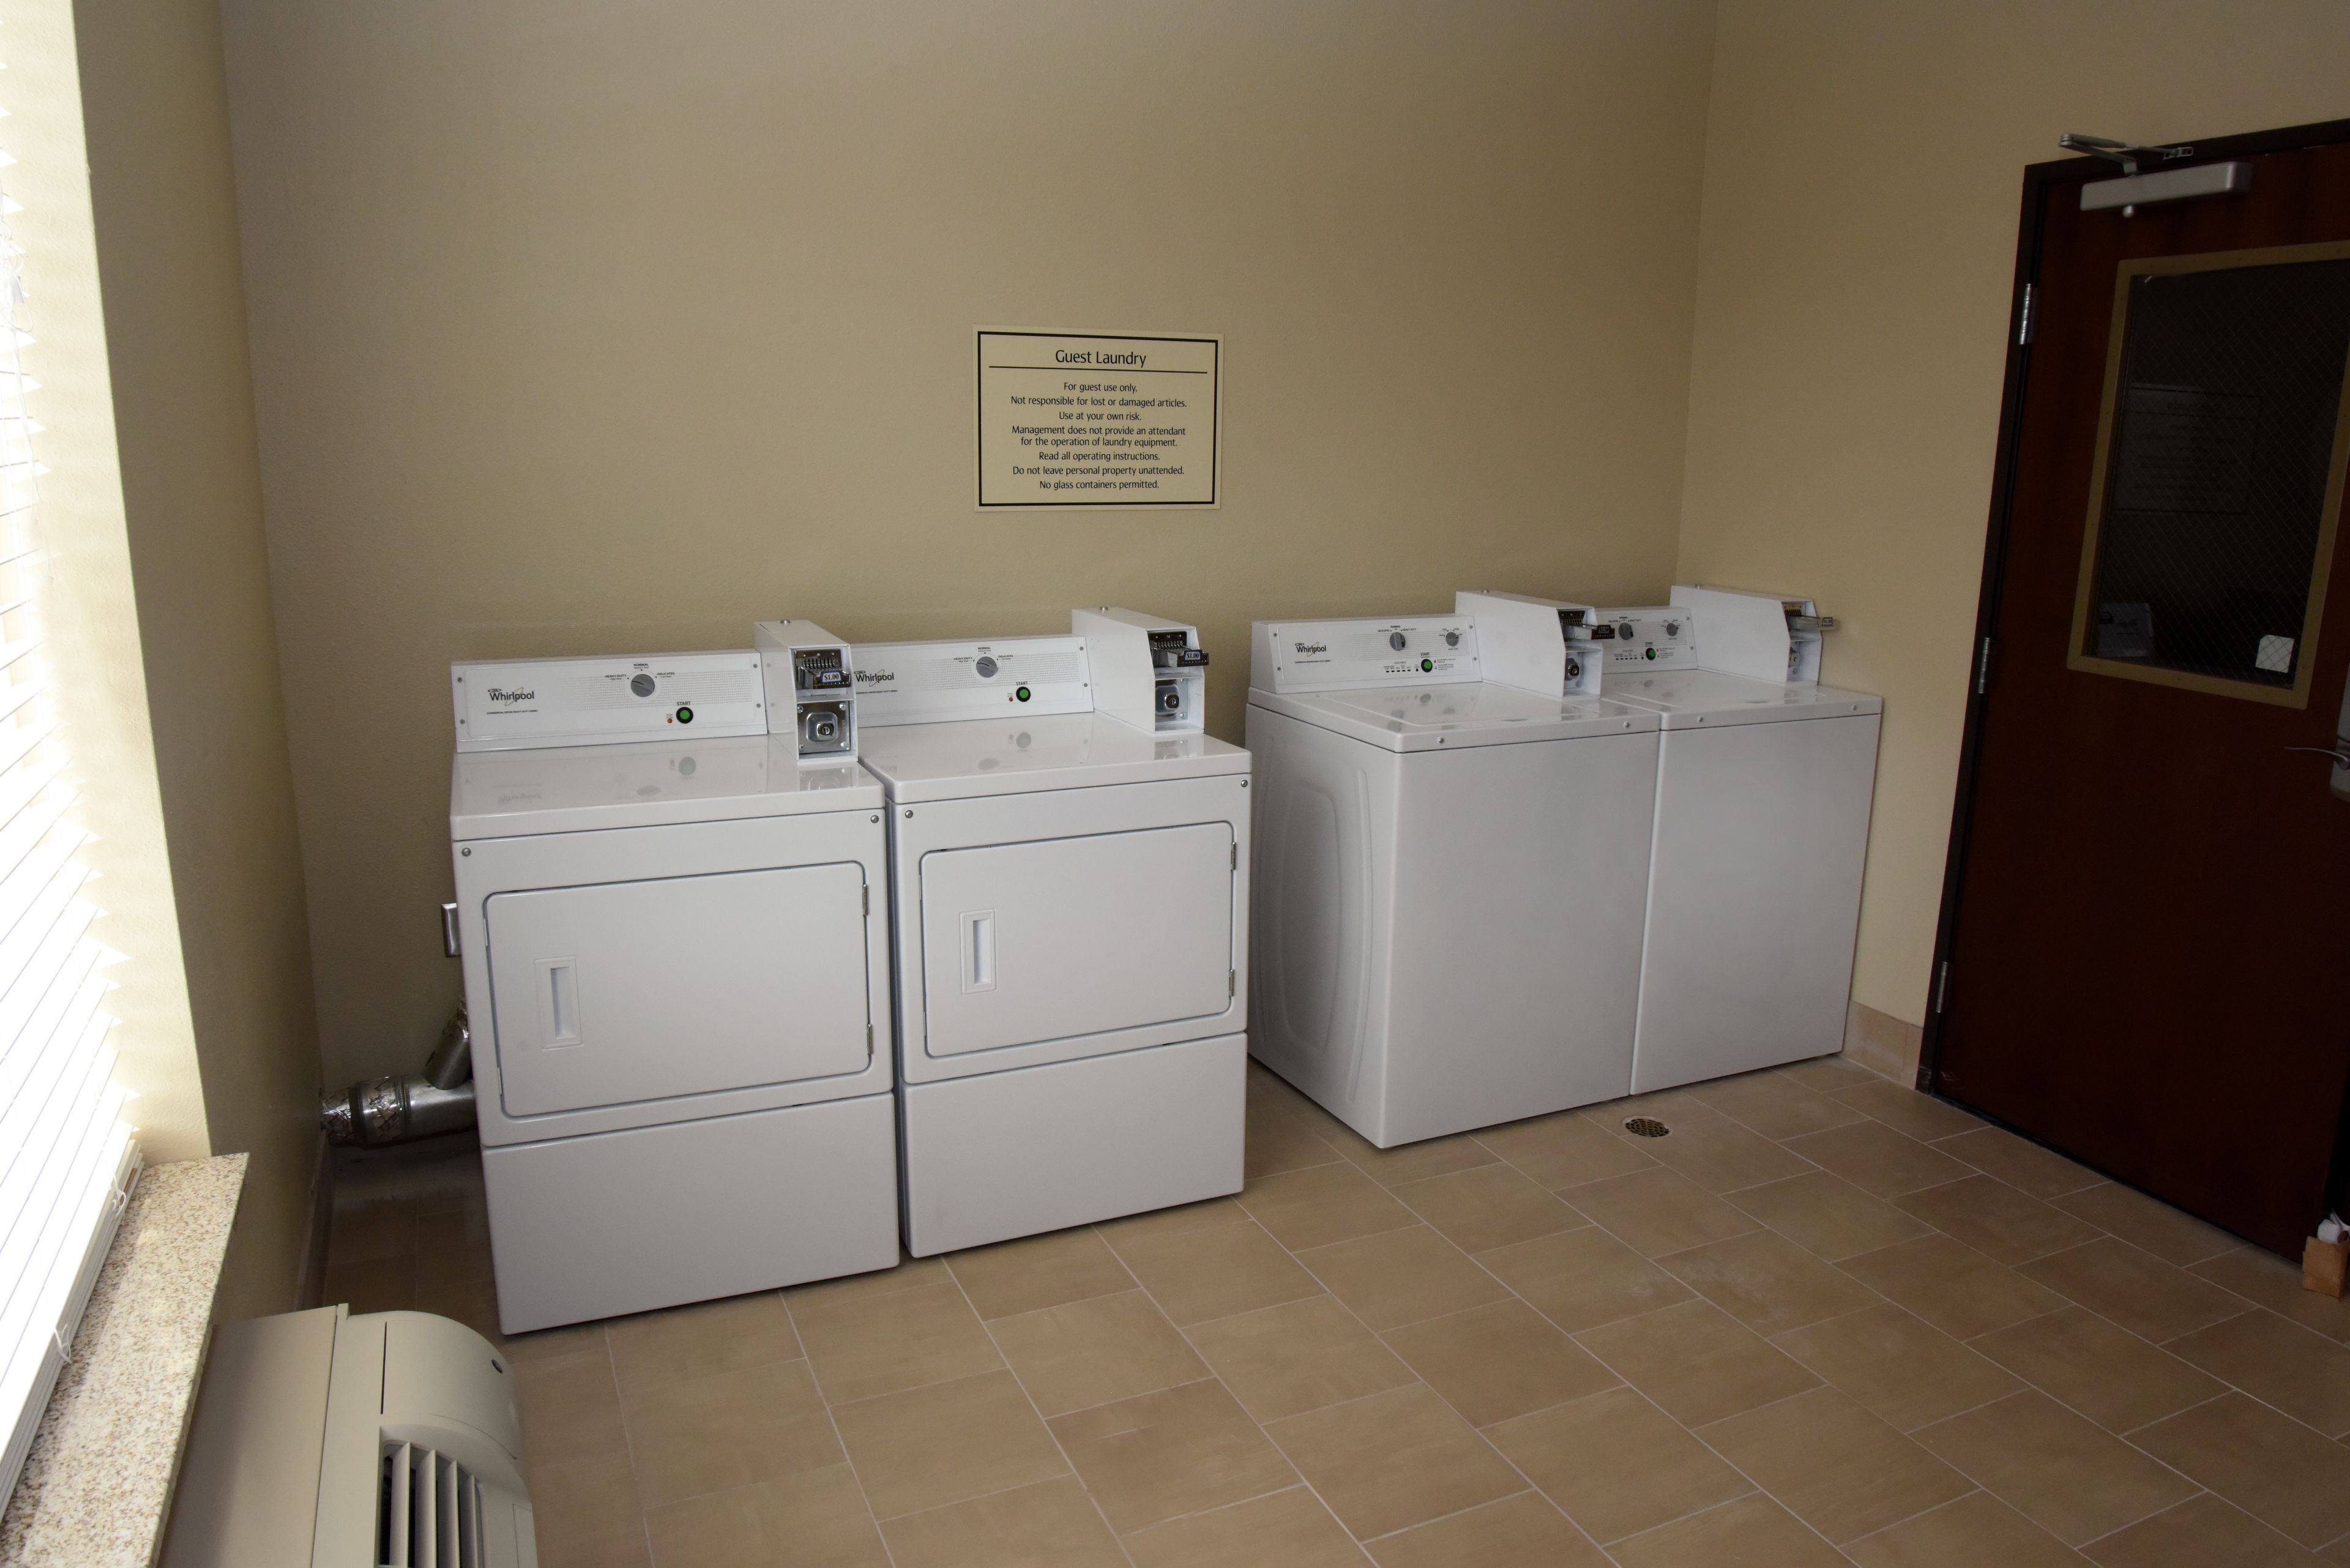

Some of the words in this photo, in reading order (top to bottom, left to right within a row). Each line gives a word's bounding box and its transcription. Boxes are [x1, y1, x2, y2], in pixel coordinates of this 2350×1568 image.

[1055, 349, 1092, 364] Guest
[1096, 351, 1146, 368] Laundry
[1064, 382, 1076, 390] For
[1079, 383, 1101, 392] guest
[1119, 383, 1137, 394] only.
[1011, 395, 1026, 405] Not
[1028, 396, 1074, 406] responsible
[1076, 396, 1088, 405] for
[1091, 397, 1105, 406] lost
[1118, 397, 1155, 408] damaged
[1157, 398, 1187, 407] articles.
[1059, 411, 1073, 419] Use
[1075, 411, 1084, 420] at
[1125, 411, 1141, 420] risk.
[1012, 425, 1065, 436] Management
[1067, 425, 1087, 434] does
[1105, 427, 1134, 436] provide
[1148, 427, 1185, 435] attendant
[1020, 436, 1032, 446] for
[1034, 436, 1048, 446] the
[1050, 436, 1089, 447] operation
[1091, 436, 1100, 446] of
[1102, 436, 1132, 448] laundry
[1134, 437, 1177, 448] equipment.
[1039, 451, 1059, 460] Read
[1061, 451, 1070, 460] all
[1072, 451, 1111, 462] operating
[1113, 451, 1160, 460] instructions.
[1013, 466, 1024, 474] Do
[1043, 465, 1063, 474] leave
[1065, 465, 1100, 476] personal
[1102, 466, 1136, 476] property
[1138, 465, 1184, 474] unattended.
[1039, 480, 1051, 489] No
[1053, 479, 1073, 490] glass
[1075, 479, 1116, 488] containers
[1119, 479, 1158, 490] permitted.
[1296, 644, 1327, 654] Whirlpool
[856, 672, 894, 683] Whirlpool
[490, 690, 534, 703] Whirlpool
